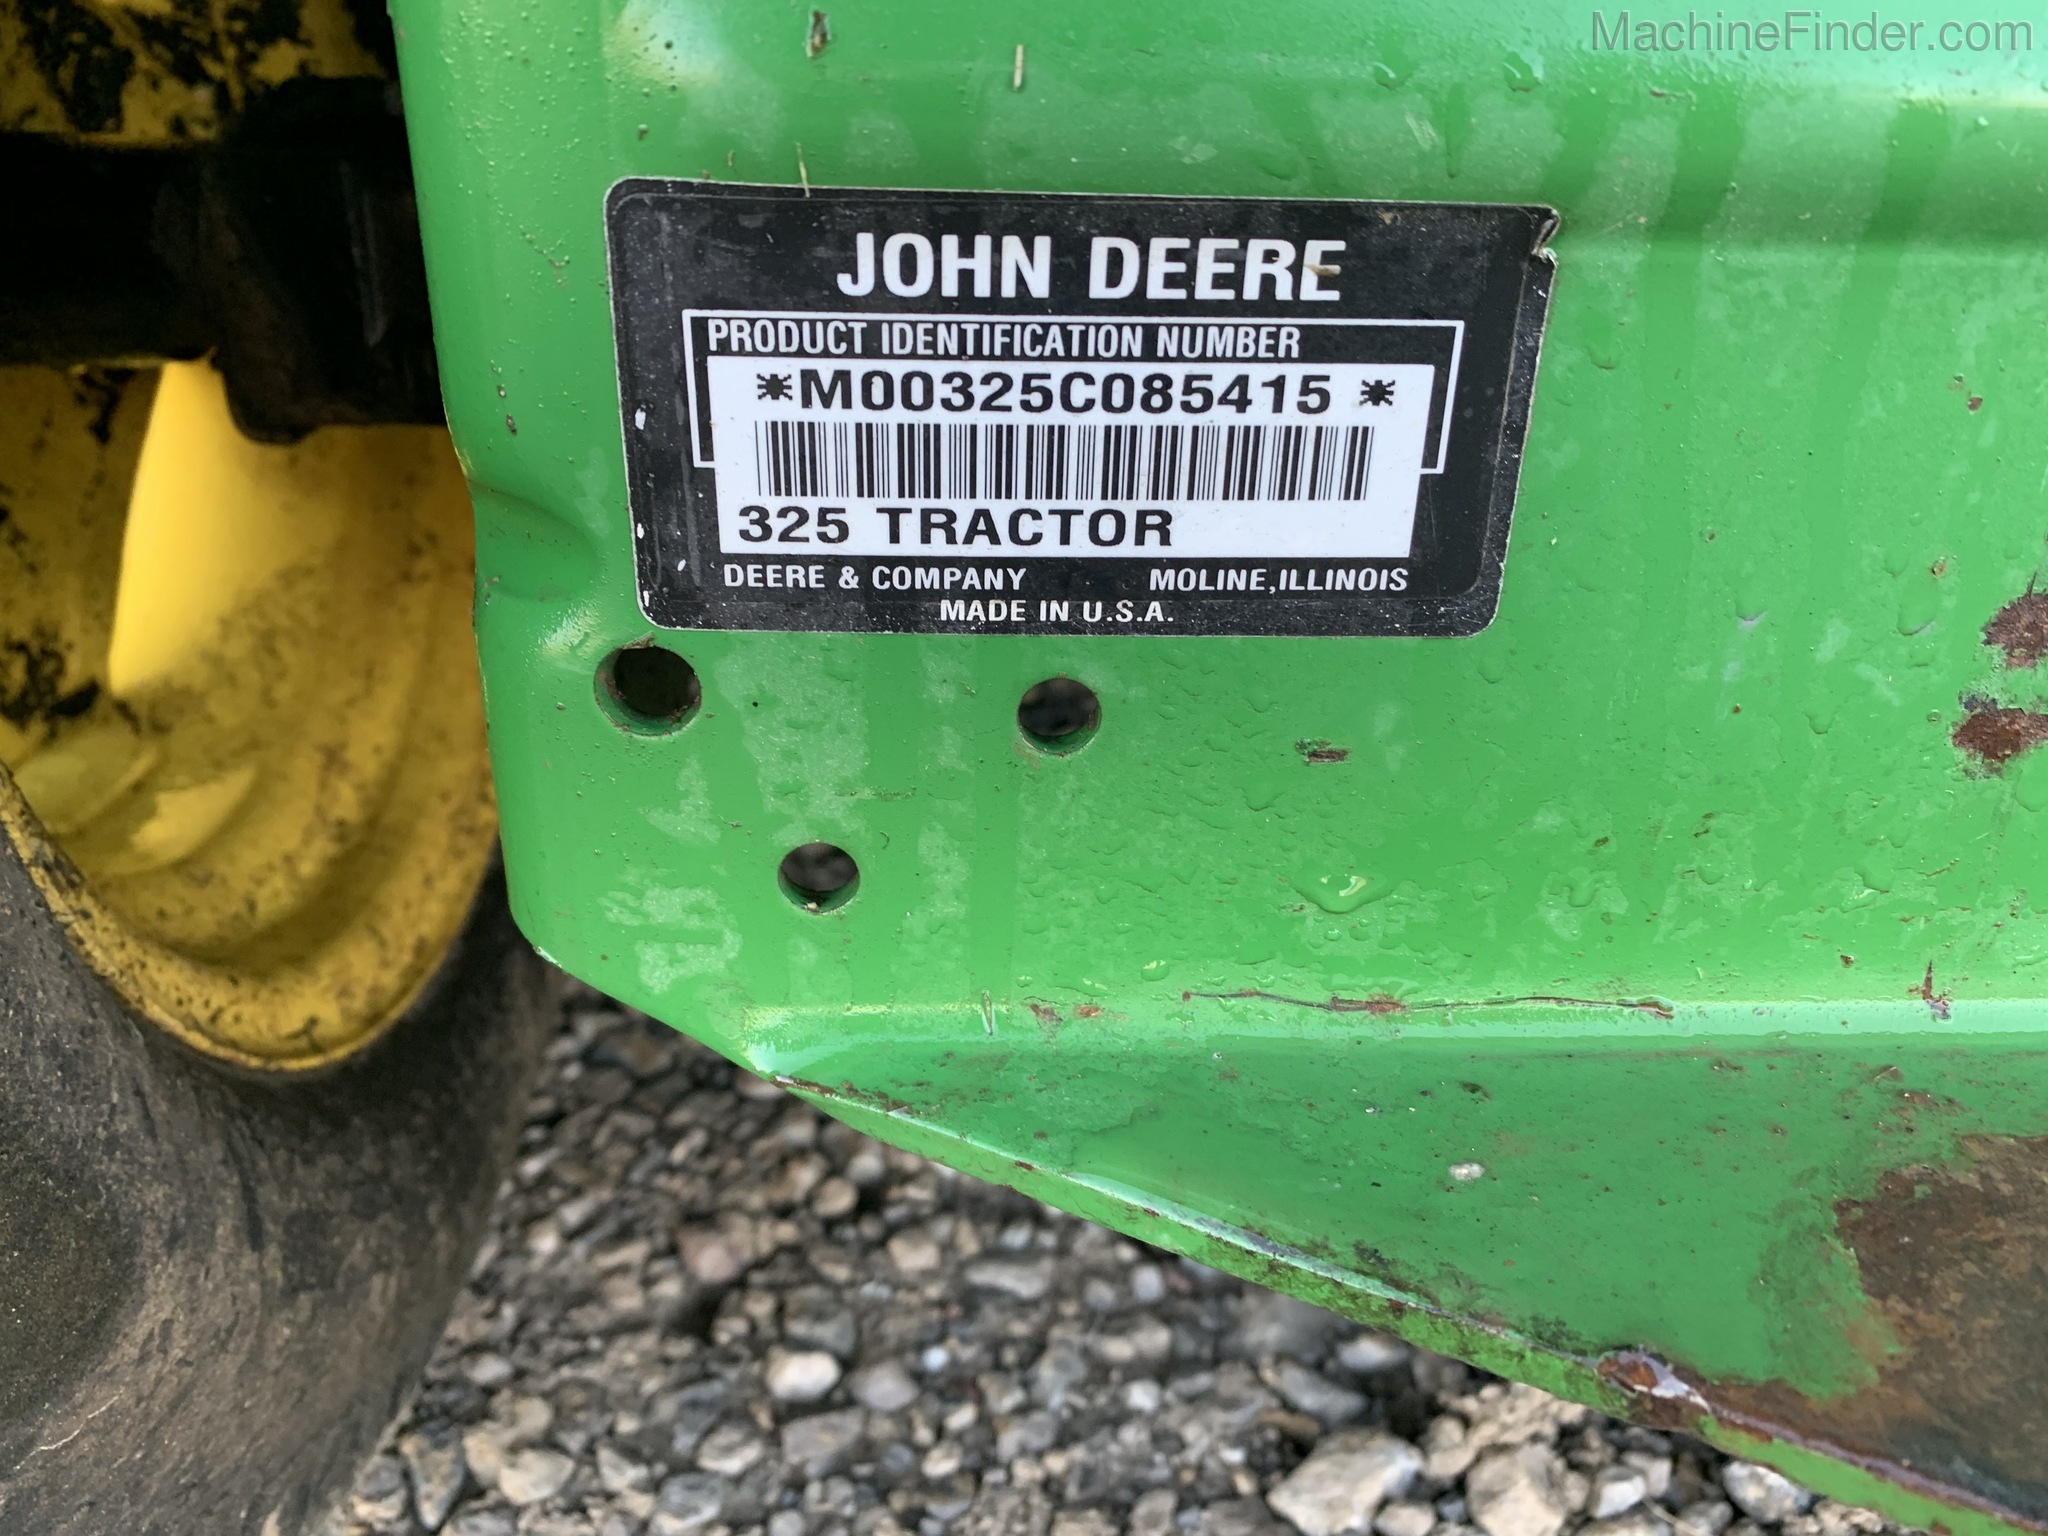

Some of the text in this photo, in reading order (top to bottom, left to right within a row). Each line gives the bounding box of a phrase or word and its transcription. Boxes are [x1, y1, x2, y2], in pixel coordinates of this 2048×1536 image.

[836, 232, 1347, 301] JOHN DEERE
[707, 319, 1301, 360] PRODUCT IDENTIFICATION NUMBER
[738, 506, 1173, 547] 325 TRACTOR
[723, 564, 1028, 591] DEERE & COMPANY
[939, 600, 1174, 623] MADE IN U.S.A.
